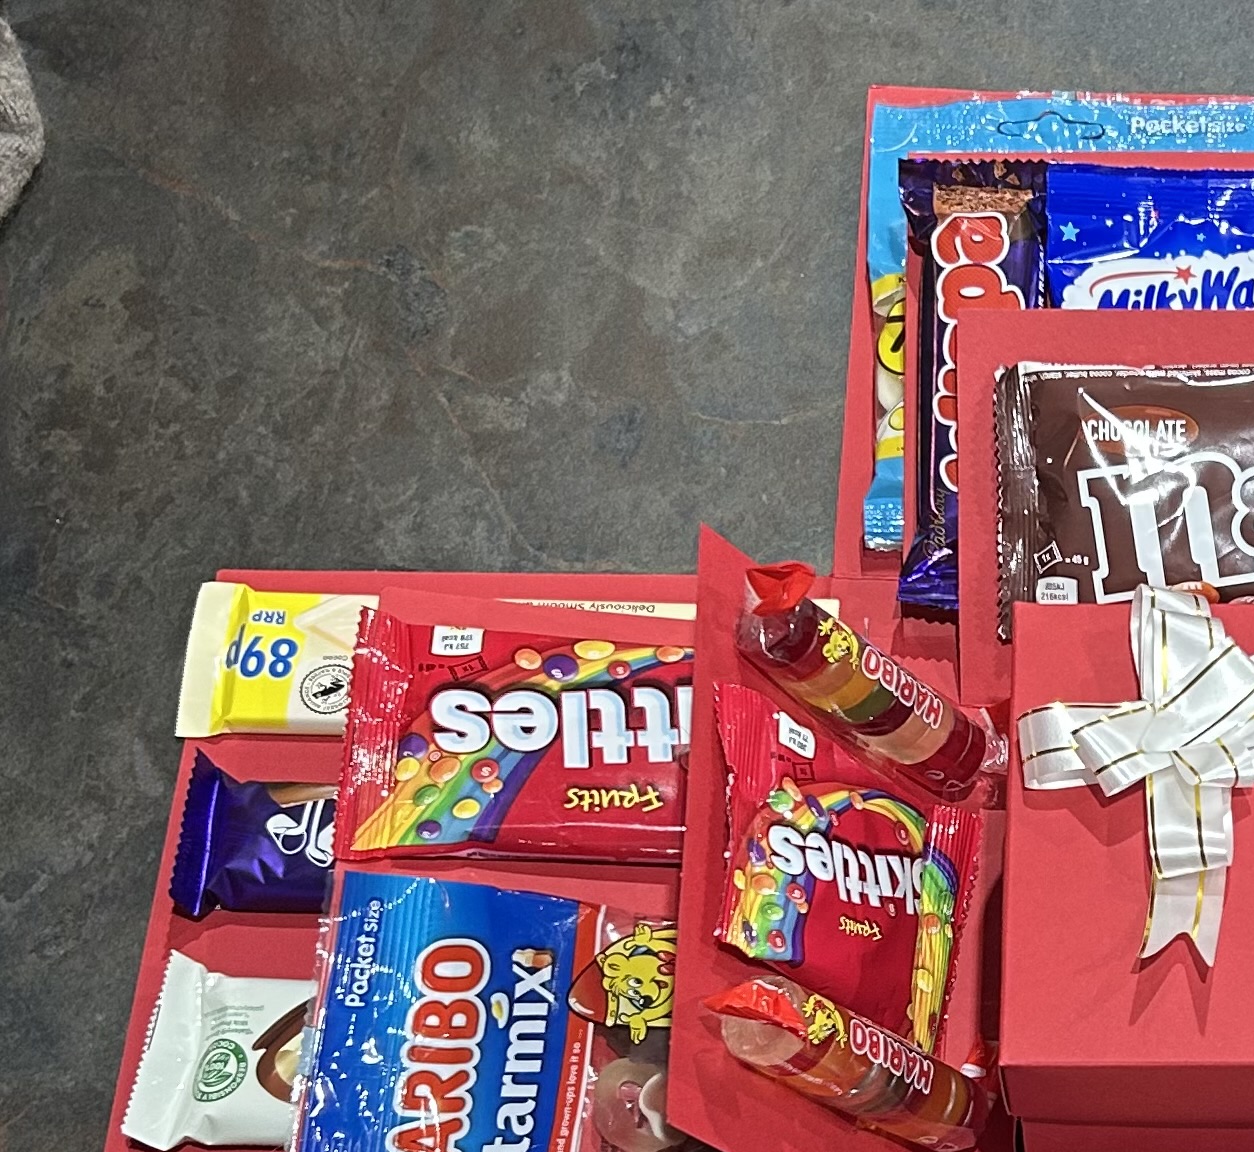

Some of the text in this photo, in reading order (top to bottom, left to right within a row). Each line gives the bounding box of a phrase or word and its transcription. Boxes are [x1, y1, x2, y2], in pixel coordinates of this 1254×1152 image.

[251, 610, 287, 625] RRP
[590, 602, 656, 614] Deliciously
[225, 622, 299, 679] 89p
[861, 645, 943, 729] HARIBO
[426, 684, 694, 769] ittles
[563, 783, 664, 813] Fruits
[838, 916, 882, 941] Fruits
[850, 1018, 934, 1095] HARIBO
